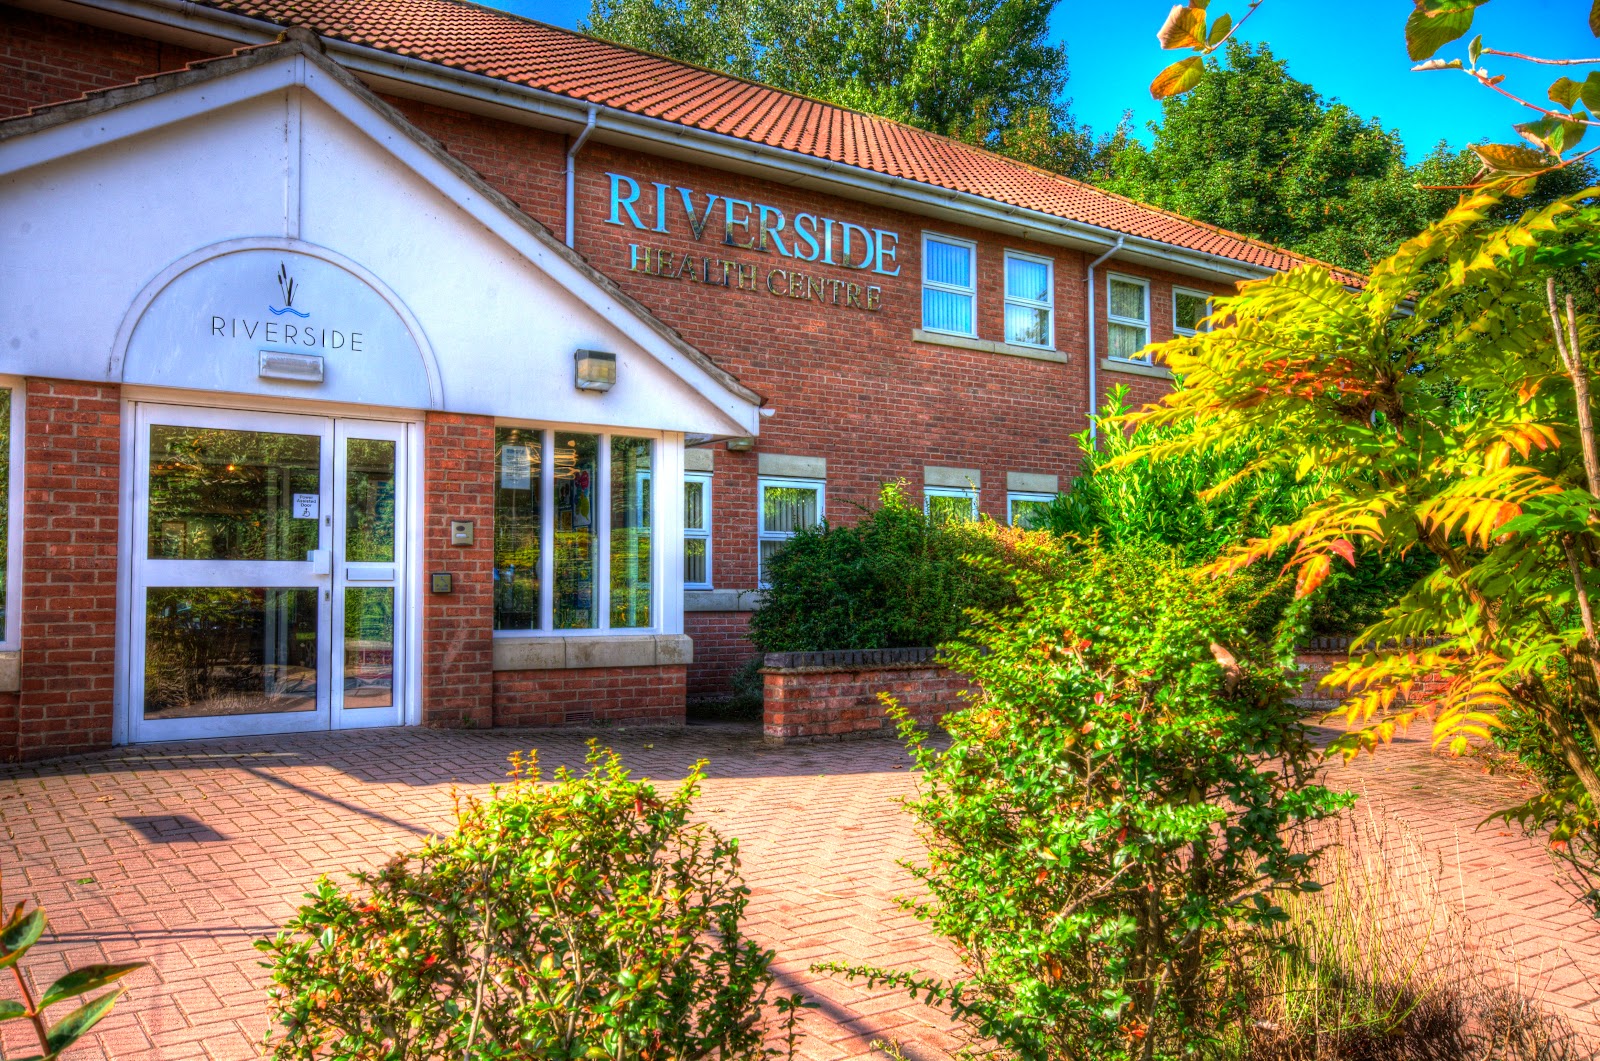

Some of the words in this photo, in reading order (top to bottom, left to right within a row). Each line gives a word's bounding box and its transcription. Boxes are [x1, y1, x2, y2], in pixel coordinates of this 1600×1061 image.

[604, 172, 901, 277] RIVERSIDE
[628, 243, 758, 292] HEALTH
[766, 268, 883, 312] CENTRE
[212, 315, 363, 352] RIVERSIDE
